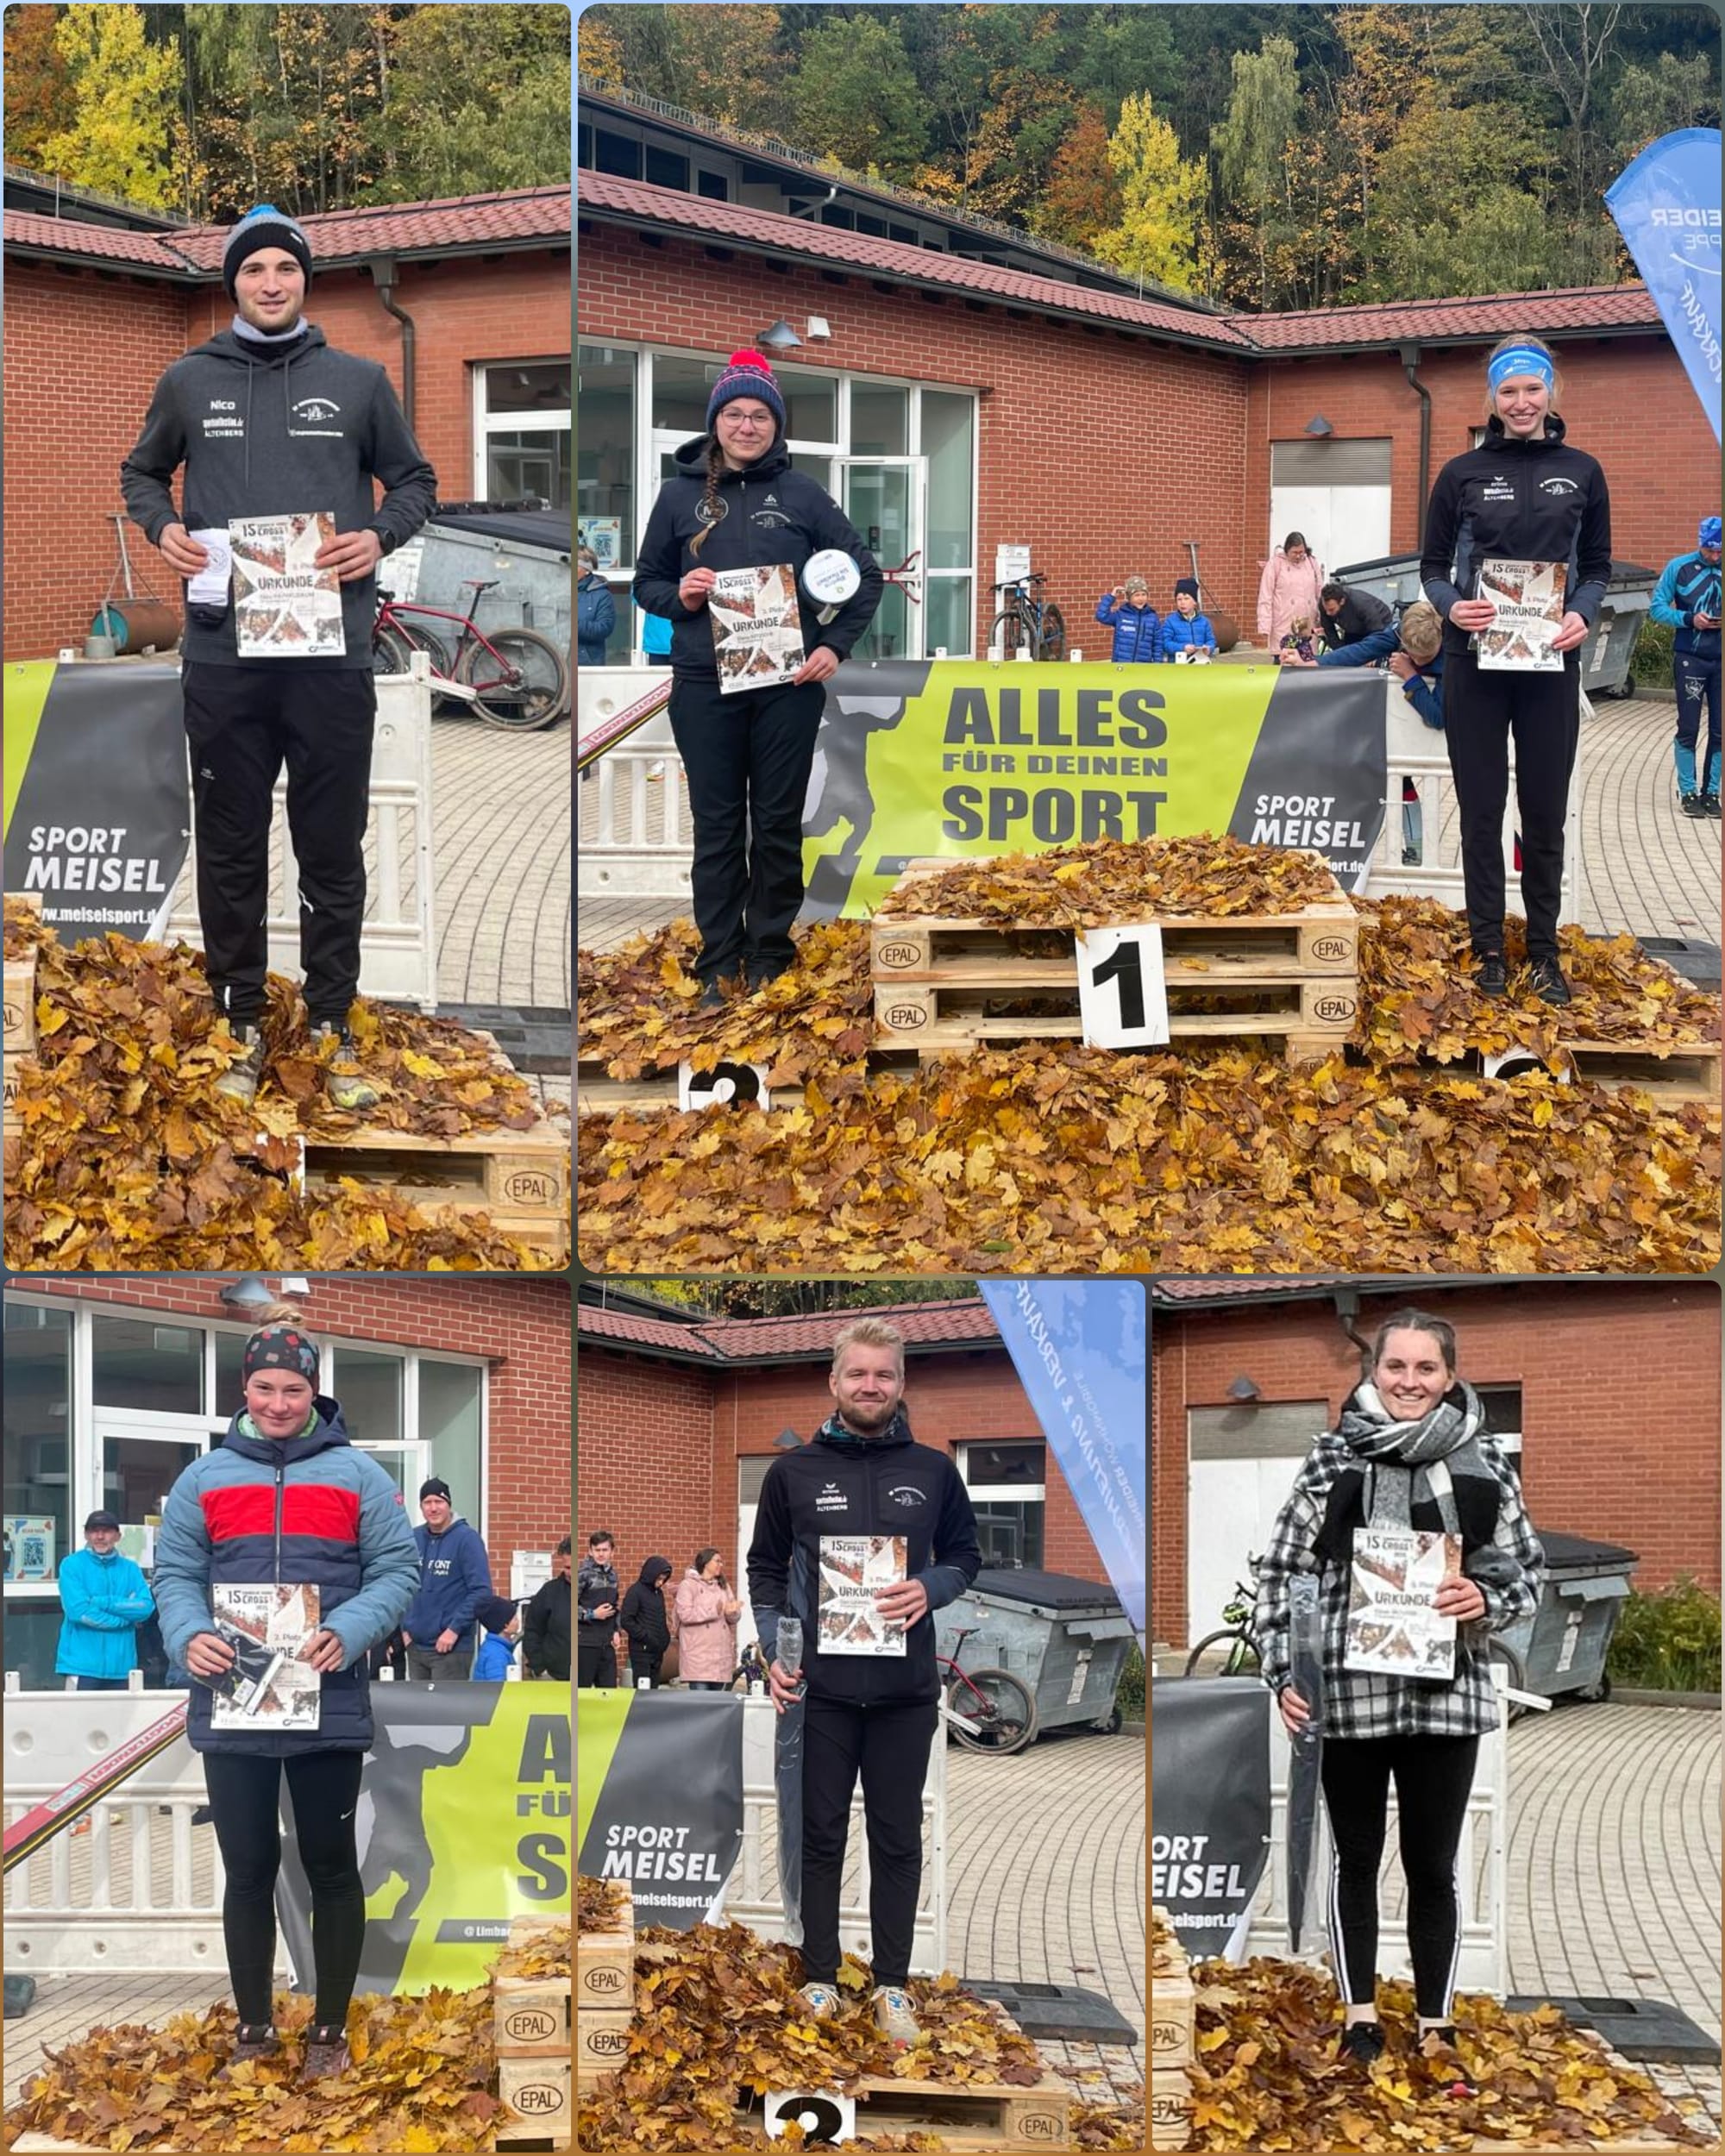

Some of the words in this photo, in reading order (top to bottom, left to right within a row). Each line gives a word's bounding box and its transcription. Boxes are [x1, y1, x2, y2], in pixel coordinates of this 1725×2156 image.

[258, 575, 314, 590] URKUNDE
[1499, 605, 1542, 617] URKUNDE
[732, 617, 780, 632] URKUNDE
[943, 687, 1168, 749] ALLES
[943, 750, 1015, 773] FÜR
[1027, 755, 1168, 776] DEINEN
[942, 785, 1168, 843] SPORT
[1254, 794, 1335, 817] SPORT
[28, 825, 127, 853] SPORT
[1250, 818, 1365, 848] MEISEL
[24, 856, 166, 892] MEISEL
[885, 949, 914, 962] EPAL
[1319, 942, 1346, 956] EPAL
[1093, 941, 1146, 1030] 1
[891, 1010, 920, 1024] EPAL
[1320, 1002, 1349, 1016] EPAL
[228, 1590, 241, 1604] 15
[1375, 1591, 1431, 1606] URKUNDE
[518, 1714, 571, 1783] A
[518, 1790, 571, 1817] FÜ
[605, 1825, 689, 1848] SPORT
[1151, 1835, 1209, 1861] ORT
[518, 1833, 568, 1901] S
[601, 1850, 721, 1882] MEISEL
[1151, 1864, 1246, 1898] EISEL
[591, 1973, 621, 1988] EPAL
[513, 2017, 548, 2034] EPAL
[594, 2035, 624, 2050] EPAL
[521, 2091, 555, 2109] EPAL
